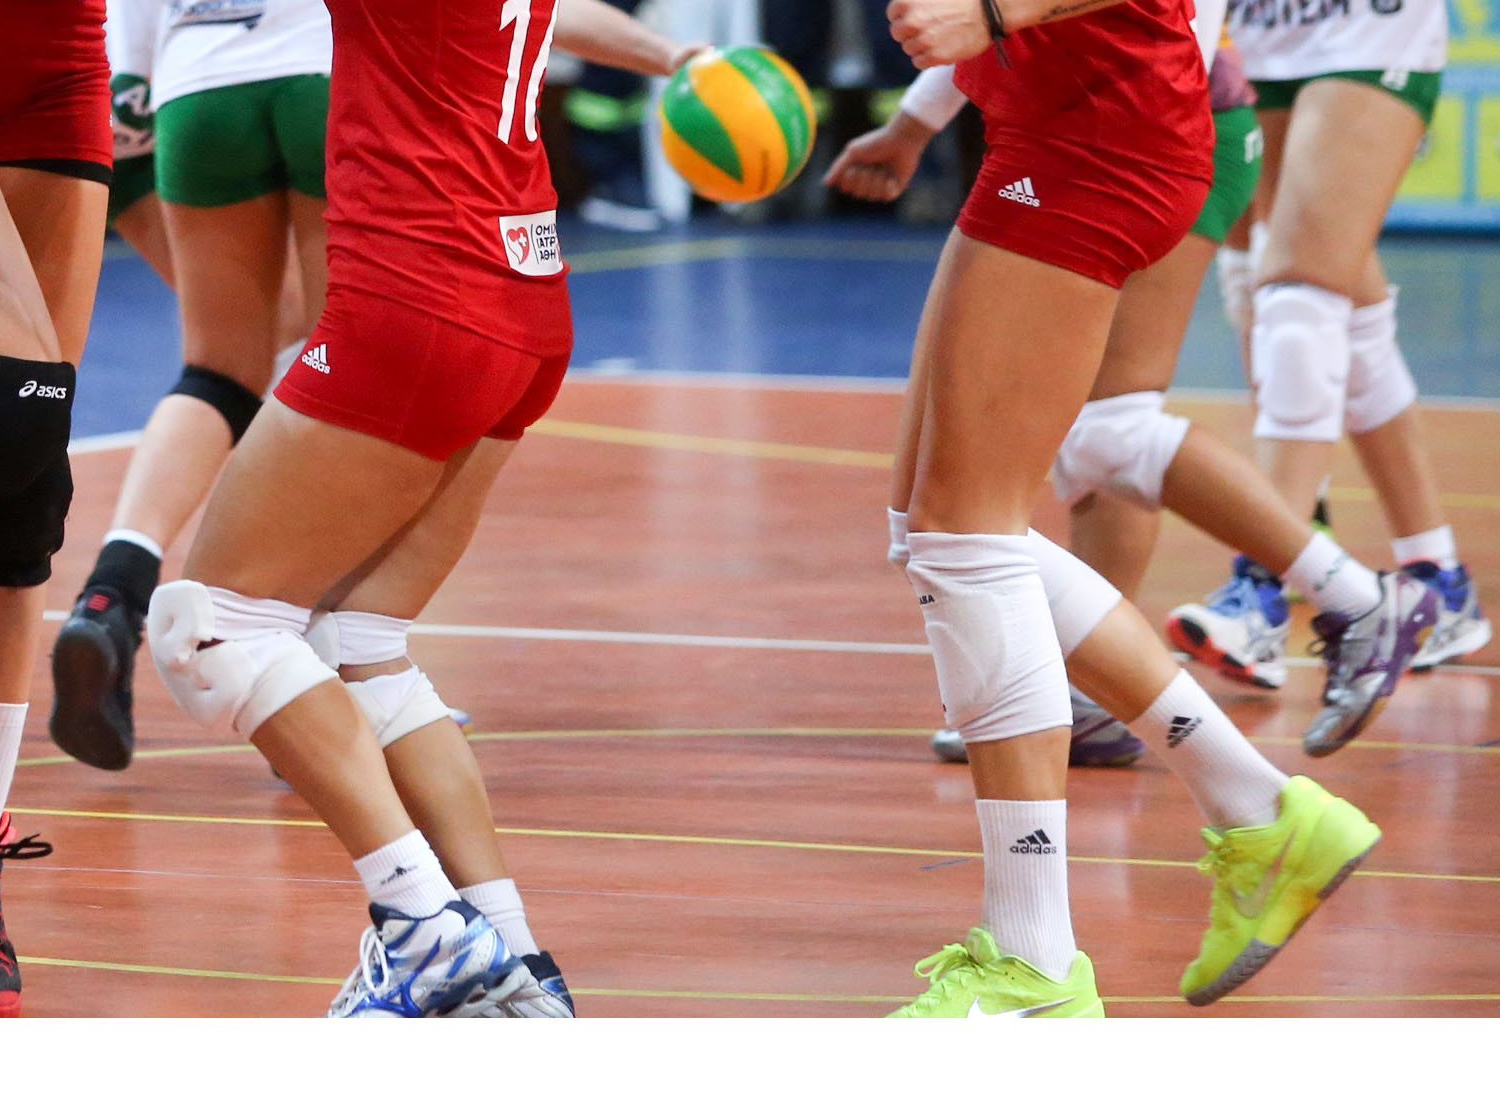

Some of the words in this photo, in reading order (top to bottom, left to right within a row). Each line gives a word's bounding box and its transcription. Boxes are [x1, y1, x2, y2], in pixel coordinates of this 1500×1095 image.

[998, 189, 1040, 207] adidas
[36, 385, 67, 399] asics
[1009, 844, 1057, 855] adidas
